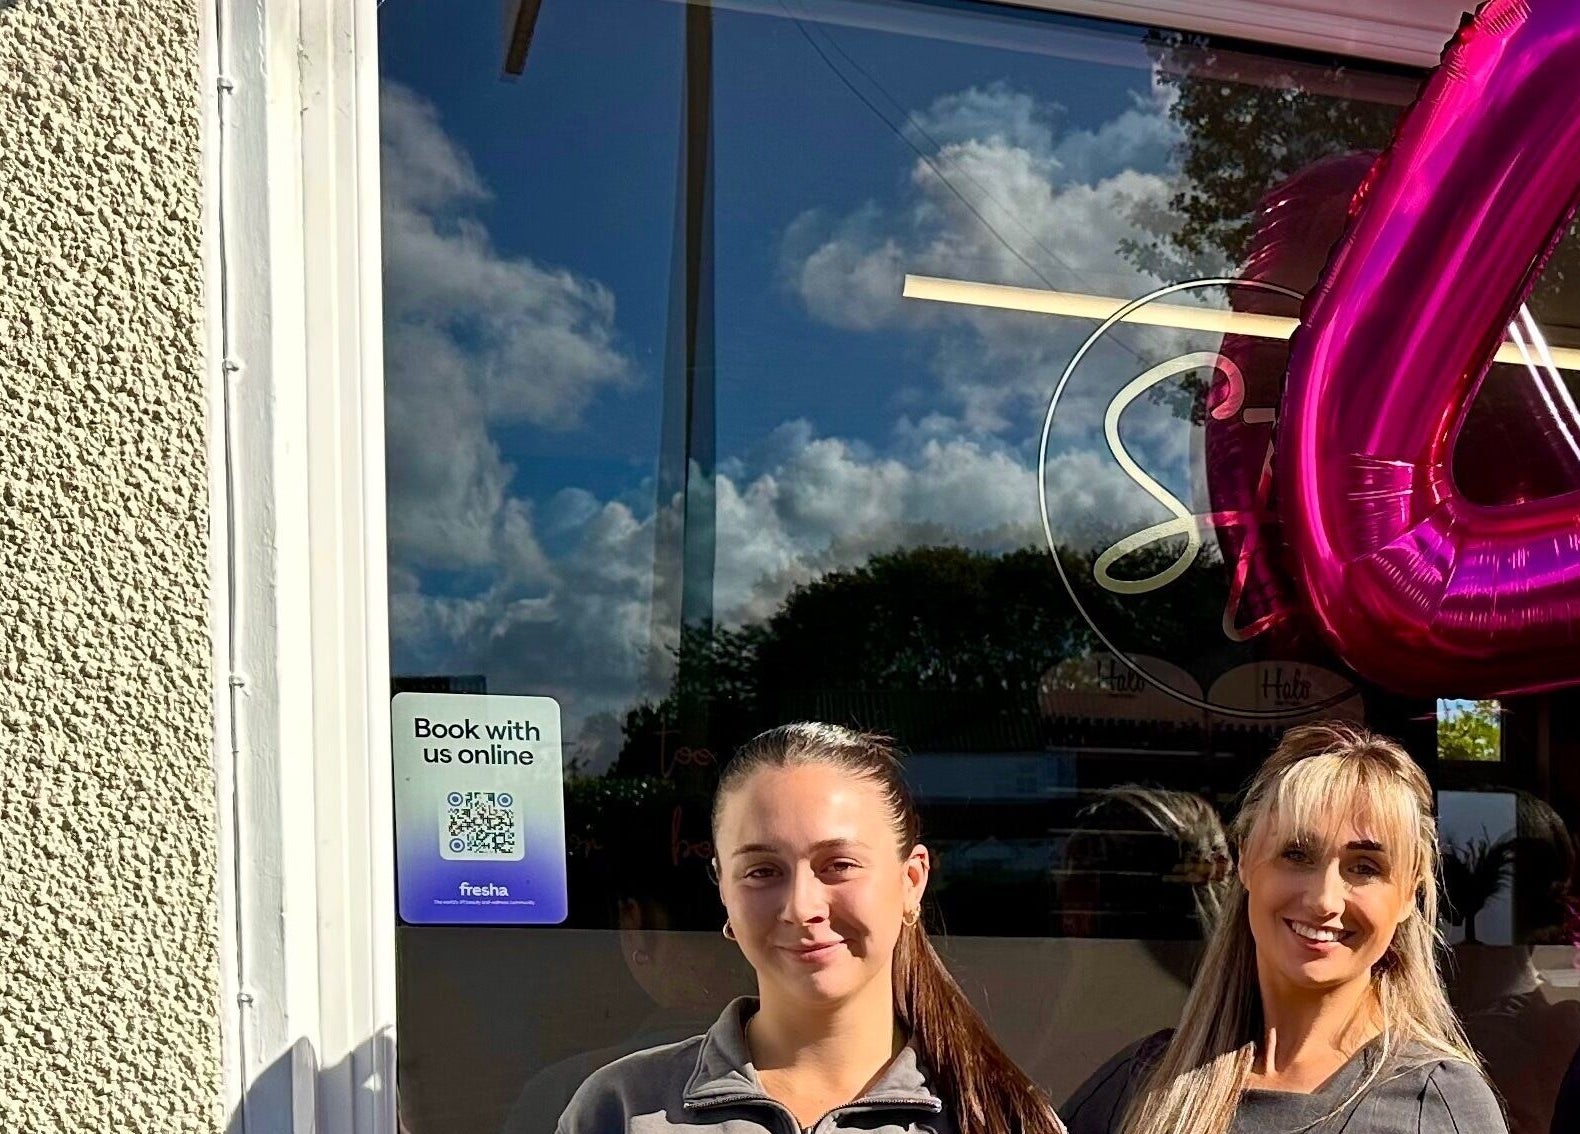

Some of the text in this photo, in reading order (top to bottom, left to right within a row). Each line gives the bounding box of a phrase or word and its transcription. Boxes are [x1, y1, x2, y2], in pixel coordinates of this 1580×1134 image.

[1261, 667, 1312, 700] Halo
[414, 717, 541, 741] Book with
[423, 744, 534, 765] us online
[458, 881, 509, 897] fresha
